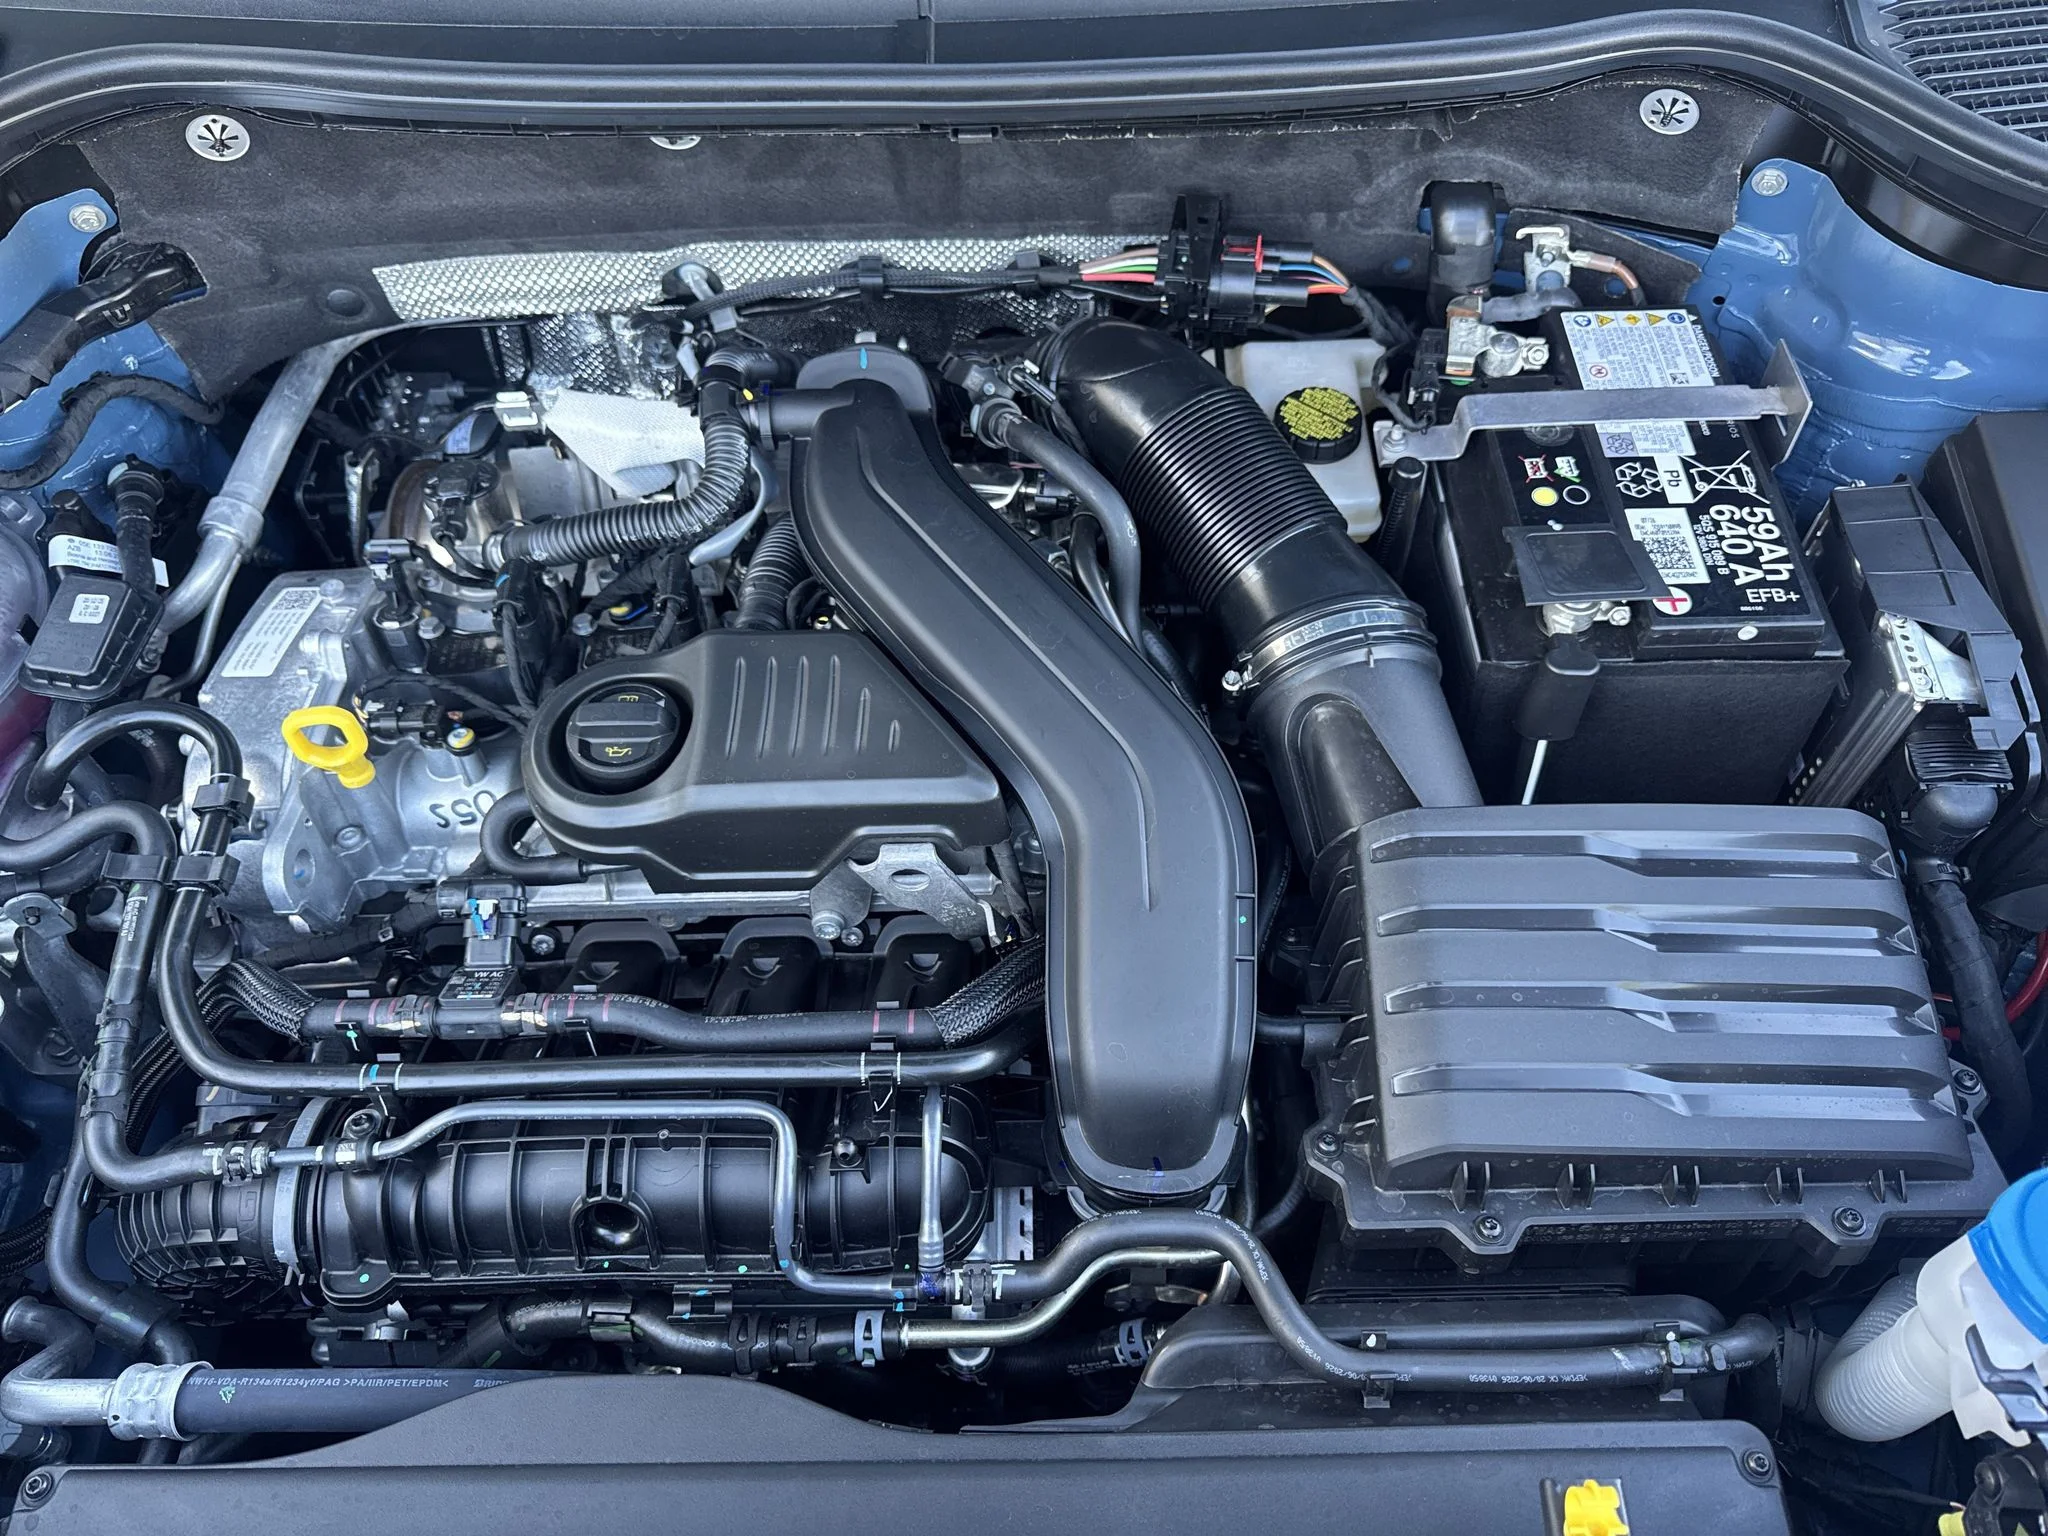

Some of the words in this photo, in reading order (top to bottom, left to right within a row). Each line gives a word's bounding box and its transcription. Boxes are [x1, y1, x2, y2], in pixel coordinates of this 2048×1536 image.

[1663, 469, 1682, 488] Pb
[1709, 504, 1755, 555] 640
[1741, 506, 1795, 581] 59Ah
[1706, 534, 1721, 549] 915
[1717, 567, 1730, 575] B
[1728, 563, 1766, 586] A
[1746, 588, 1800, 603] EFB+
